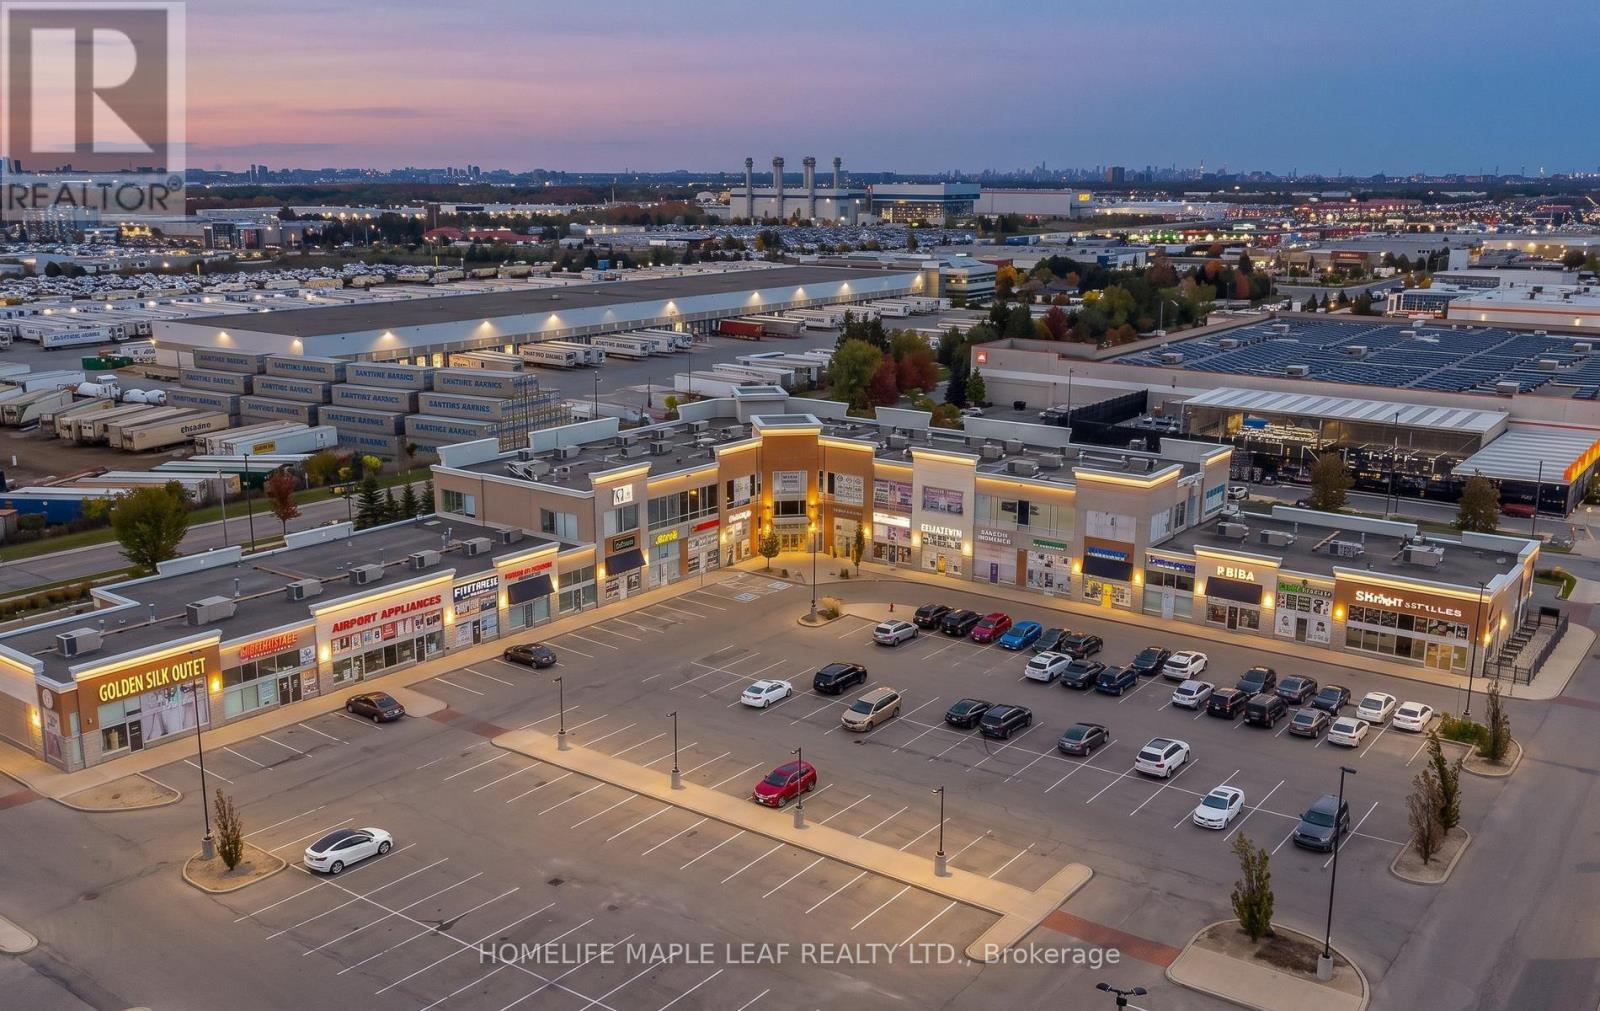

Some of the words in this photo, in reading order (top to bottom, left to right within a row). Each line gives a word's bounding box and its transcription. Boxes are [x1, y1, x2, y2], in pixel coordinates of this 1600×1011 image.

[332, 612, 378, 633] AIRPORT
[381, 594, 442, 620] APPLIANCES
[99, 676, 143, 702] GOLDEN
[146, 667, 170, 689] SILK
[172, 657, 206, 681] OUTET
